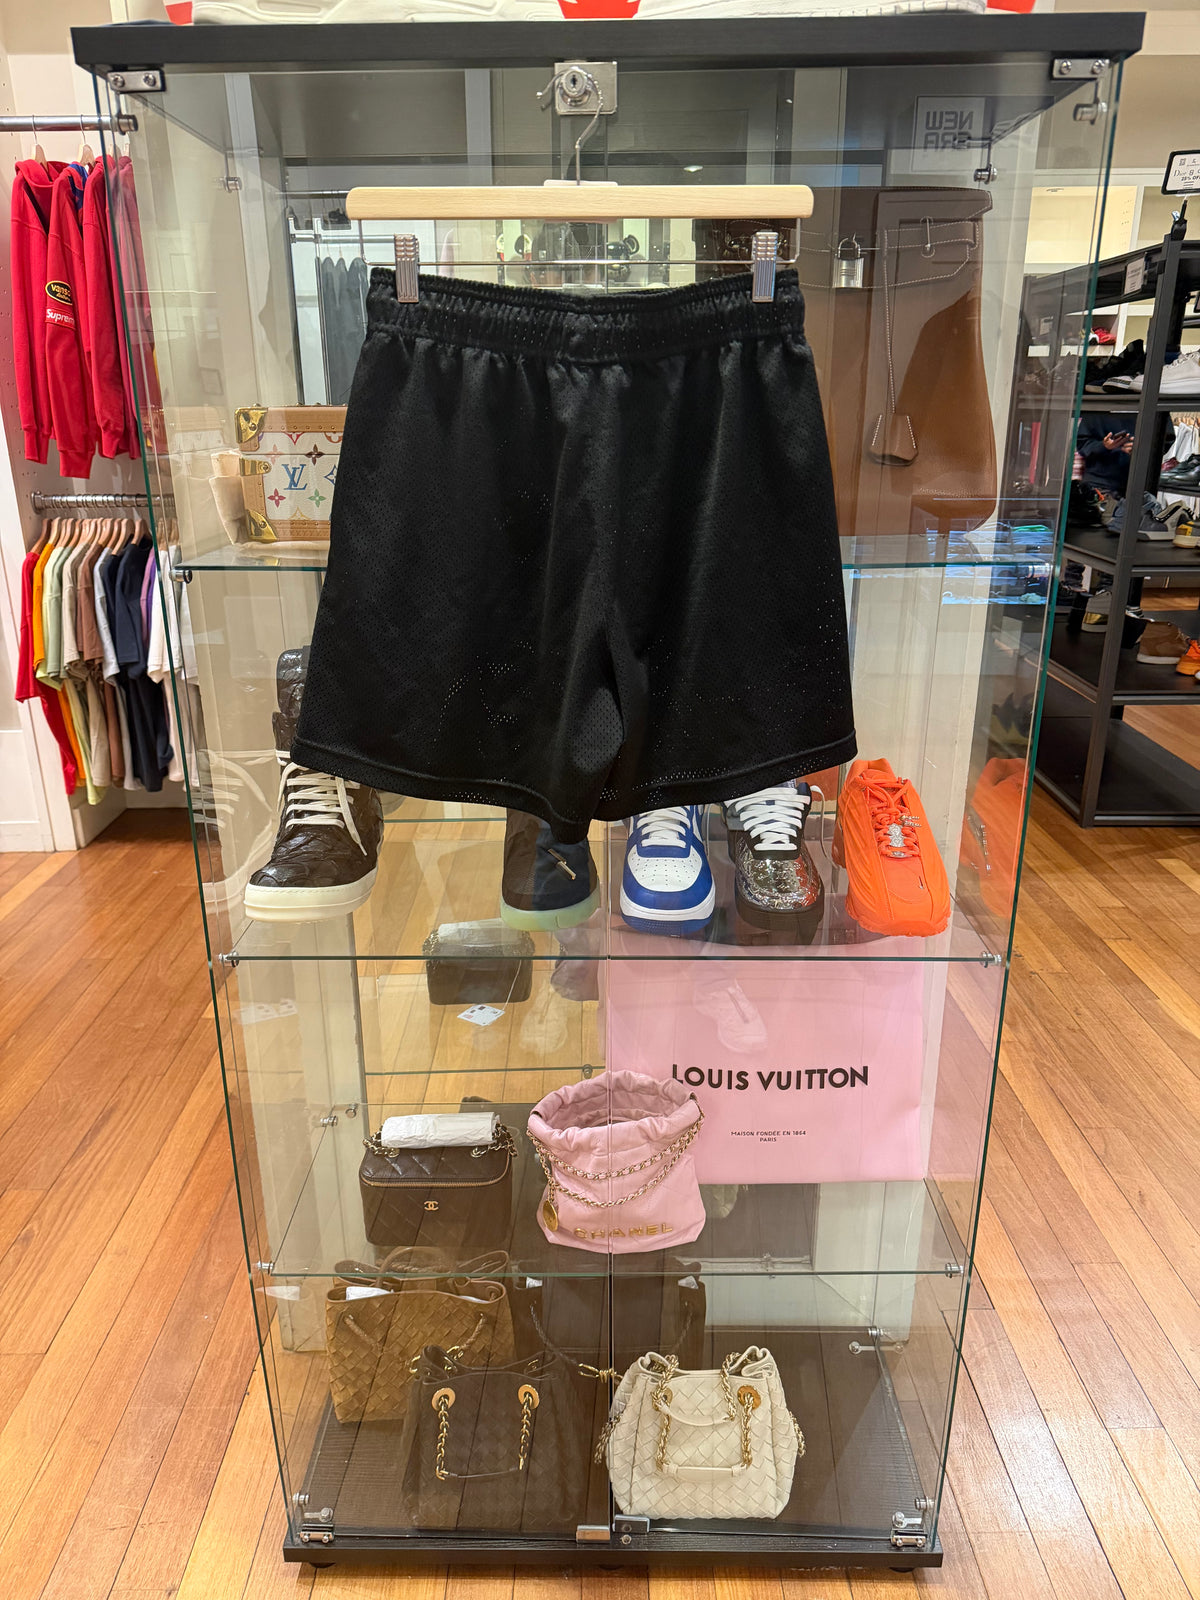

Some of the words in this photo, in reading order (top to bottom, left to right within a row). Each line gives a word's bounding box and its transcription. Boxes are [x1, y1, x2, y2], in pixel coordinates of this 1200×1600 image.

[672, 1064, 749, 1091] LOUIS
[756, 1065, 868, 1091] VUITTON
[573, 1223, 674, 1240] CHANEL
